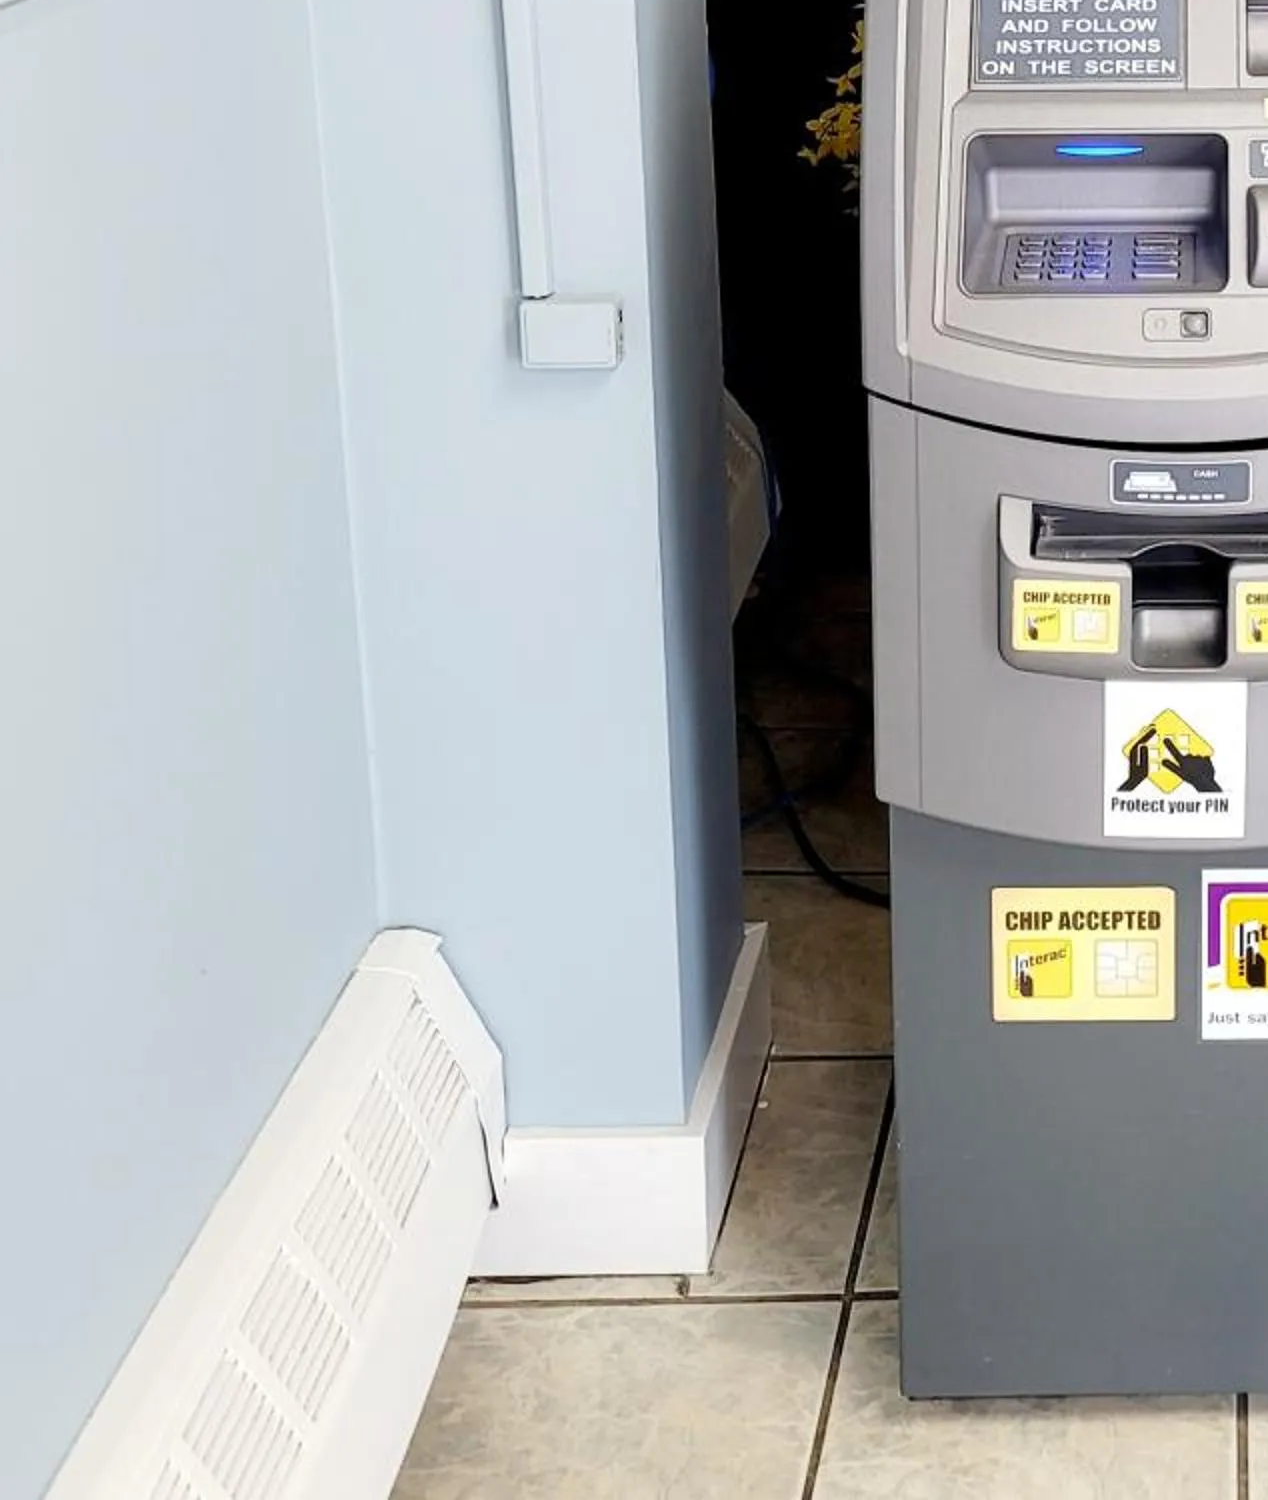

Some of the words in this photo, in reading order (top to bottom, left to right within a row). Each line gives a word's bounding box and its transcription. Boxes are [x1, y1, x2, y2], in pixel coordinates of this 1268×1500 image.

[1001, 18, 1049, 33] AND
[1062, 18, 1158, 33] FOLLOW
[996, 38, 1161, 55] INSTRUCTIONS
[981, 60, 1015, 75] ON
[1028, 59, 1072, 75] THE
[1085, 59, 1177, 74] SCREEN
[1193, 468, 1220, 478] CASH
[1023, 591, 1050, 603] CHIP
[1053, 592, 1111, 605] ACCEPTED
[1111, 796, 1165, 813] Protect
[1168, 800, 1201, 814] your
[1205, 798, 1229, 813] PIN
[1005, 911, 1053, 931] CHIP
[1058, 910, 1161, 931] ACCEPTED
[1015, 948, 1067, 976] Interac
[1207, 1011, 1240, 1024] Just
